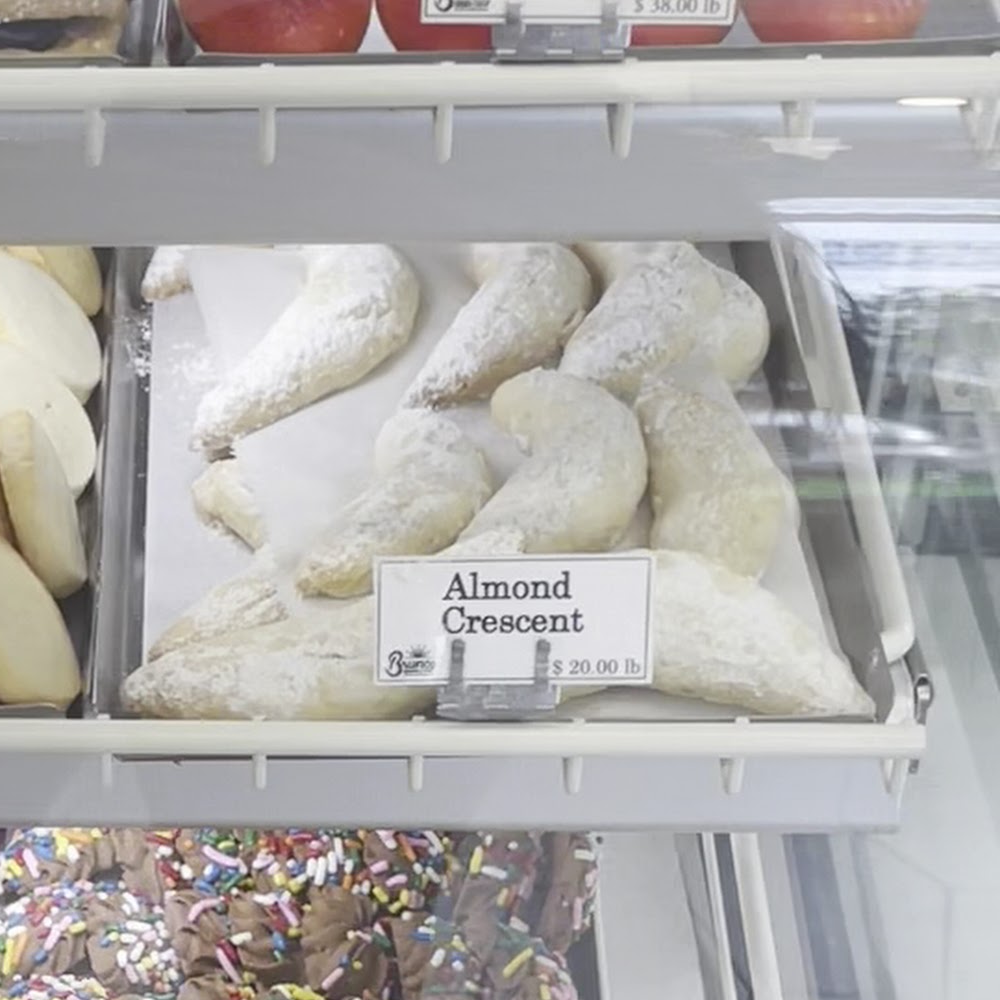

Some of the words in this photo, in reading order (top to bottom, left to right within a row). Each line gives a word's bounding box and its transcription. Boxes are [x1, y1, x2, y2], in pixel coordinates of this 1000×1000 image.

[442, 571, 573, 601] Almond
[442, 606, 585, 635] Crescent
[552, 661, 563, 676] $
[569, 660, 619, 675] 20.00
[625, 659, 641, 675] lb
